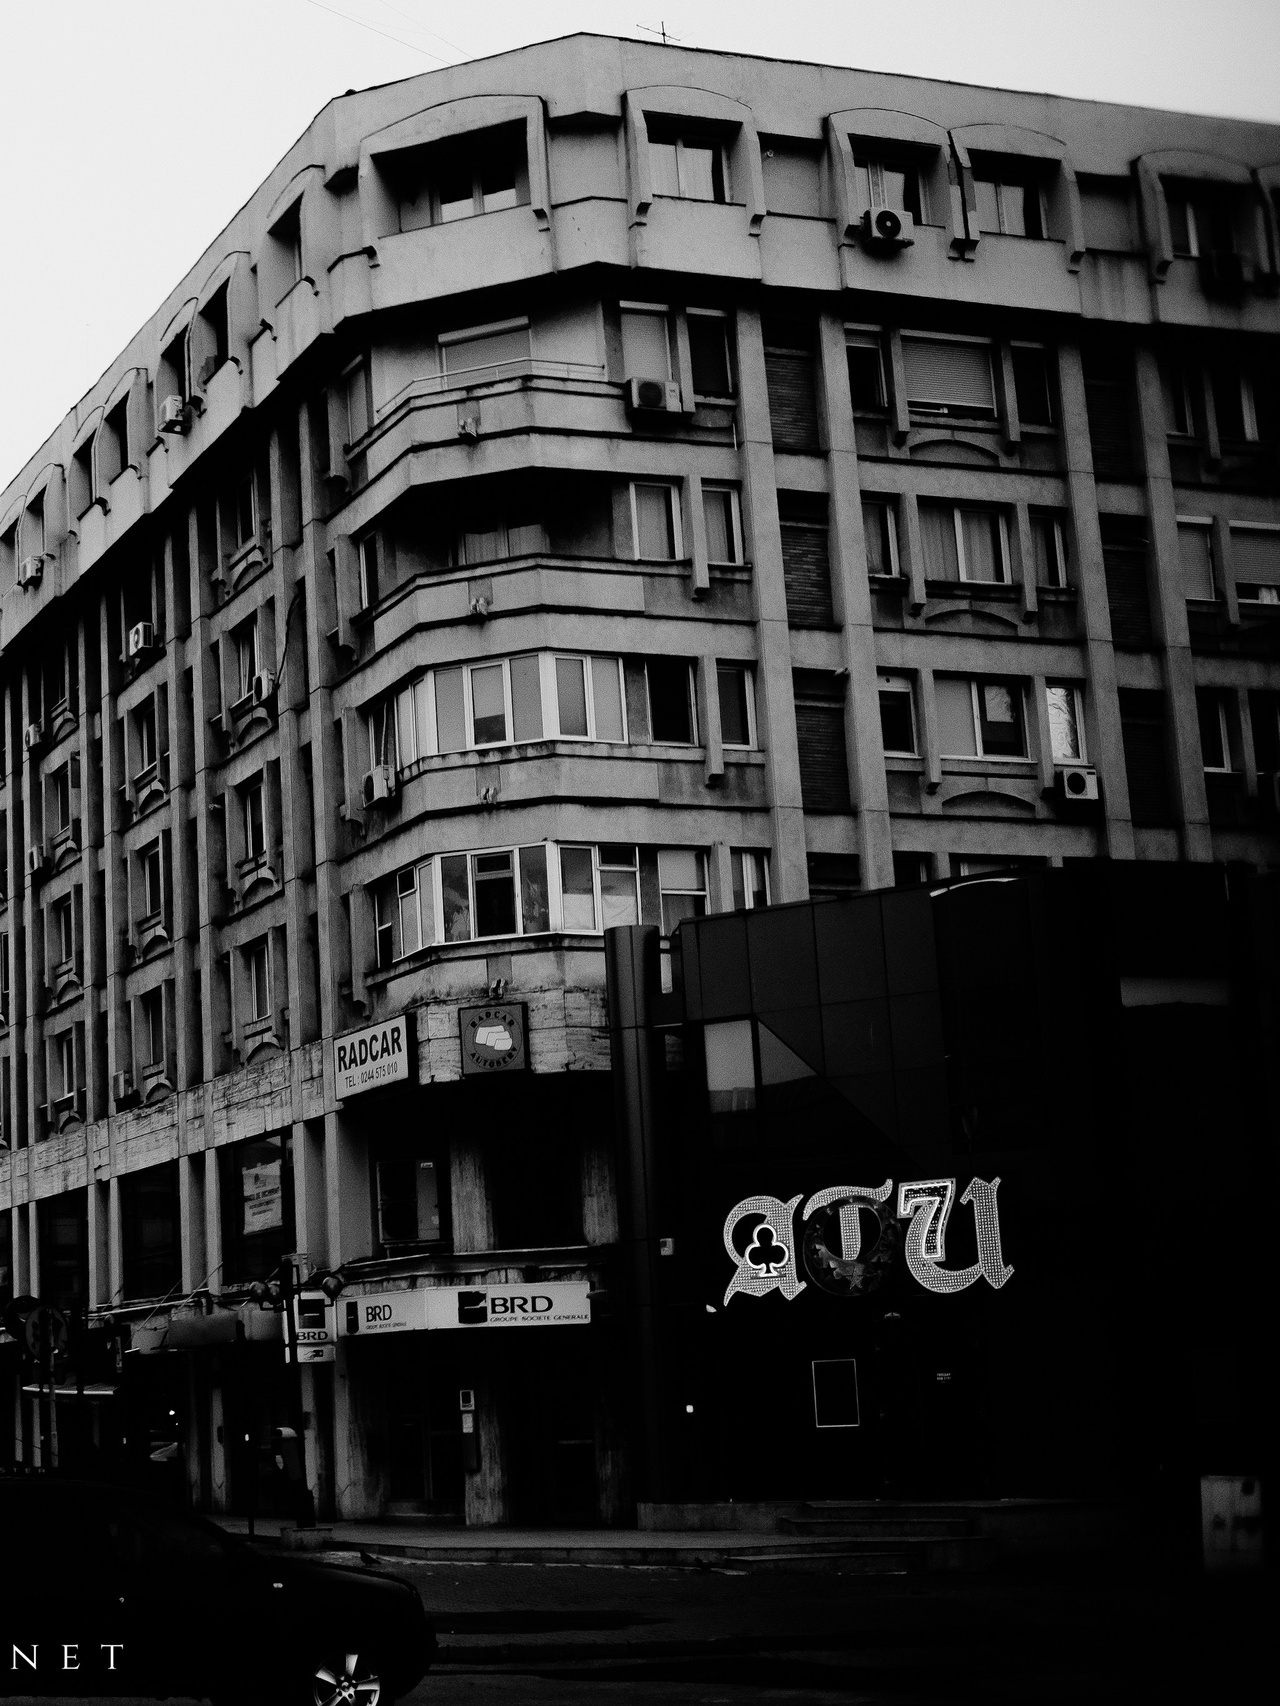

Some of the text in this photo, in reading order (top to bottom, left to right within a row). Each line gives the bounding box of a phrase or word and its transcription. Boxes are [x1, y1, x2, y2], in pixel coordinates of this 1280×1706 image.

[470, 1011, 516, 1029] RADCAR
[337, 1026, 402, 1073] RADCAR
[365, 1304, 393, 1322] BRD
[489, 1295, 554, 1314] BRD
[297, 1331, 328, 1341] BRD
